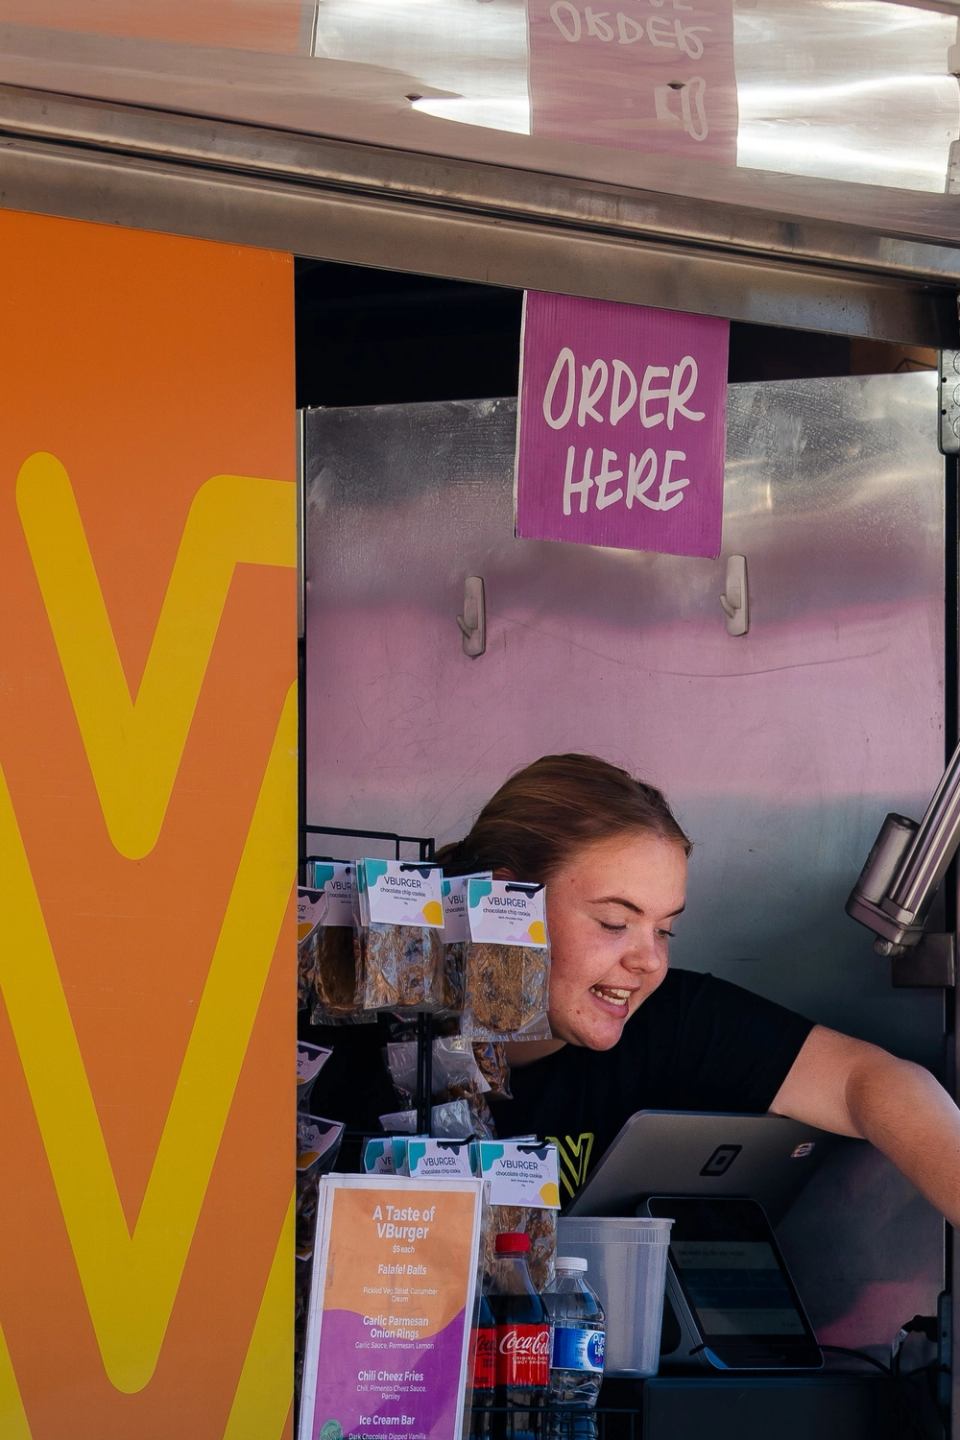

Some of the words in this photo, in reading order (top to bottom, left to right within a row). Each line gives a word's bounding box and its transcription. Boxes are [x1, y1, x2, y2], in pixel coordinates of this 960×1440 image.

[543, 347, 705, 430] ORDER
[563, 445, 690, 515] HERE
[488, 896, 527, 908] VBURGER
[500, 1159, 539, 1170] VBURGER
[372, 1206, 382, 1221] A
[386, 1206, 420, 1221] Taste
[422, 1206, 436, 1221] of
[377, 1223, 429, 1242] VBurger
[378, 1264, 406, 1276] Falafel
[407, 1264, 427, 1276] Balls
[363, 1316, 387, 1326] Garlic
[389, 1316, 429, 1326] Parmesan
[370, 1328, 396, 1338] Onion
[397, 1328, 420, 1341] Rings
[358, 1371, 376, 1382] Chili
[377, 1371, 403, 1382] Cheez
[404, 1371, 424, 1382] Fries
[359, 1415, 372, 1426] Ice
[373, 1415, 400, 1426] Cream
[401, 1415, 415, 1426] Bar
